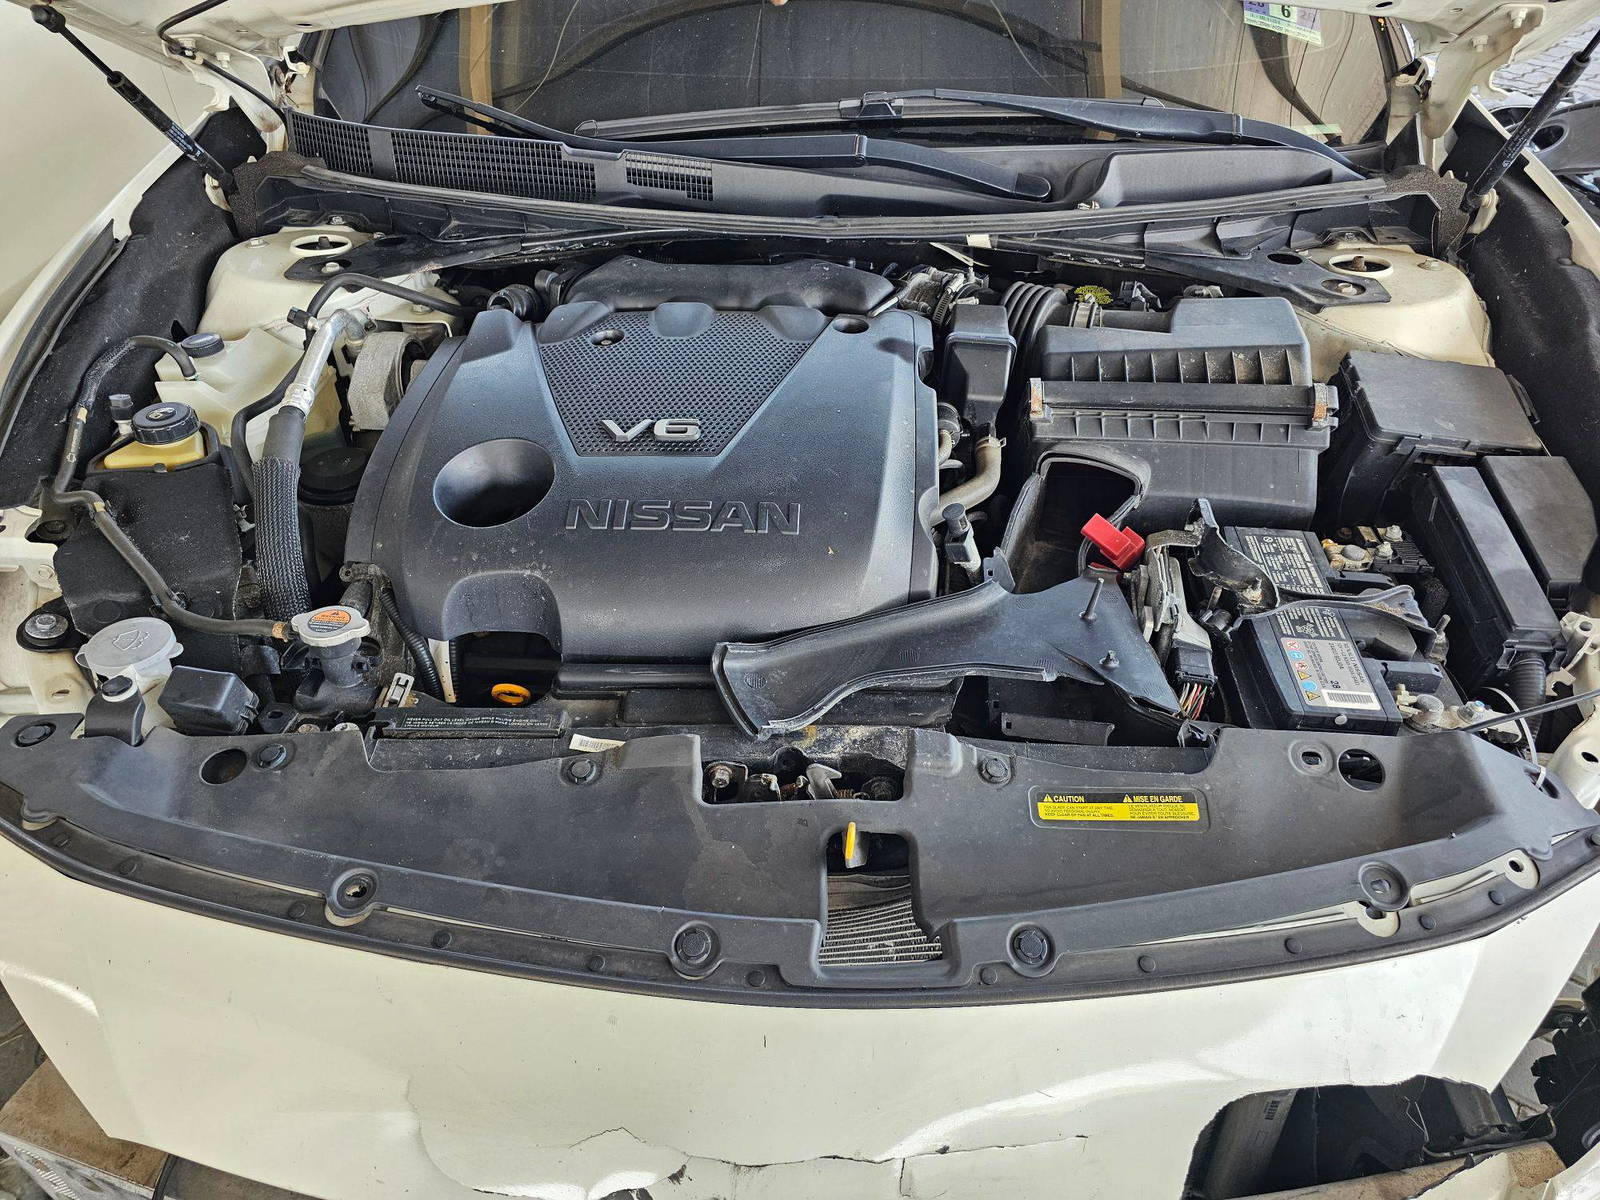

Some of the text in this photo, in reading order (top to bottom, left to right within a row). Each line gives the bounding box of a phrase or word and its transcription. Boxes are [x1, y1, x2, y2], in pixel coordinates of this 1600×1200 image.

[601, 418, 701, 442] V6
[566, 499, 800, 536] NISSAN
[1330, 680, 1341, 689] 28
